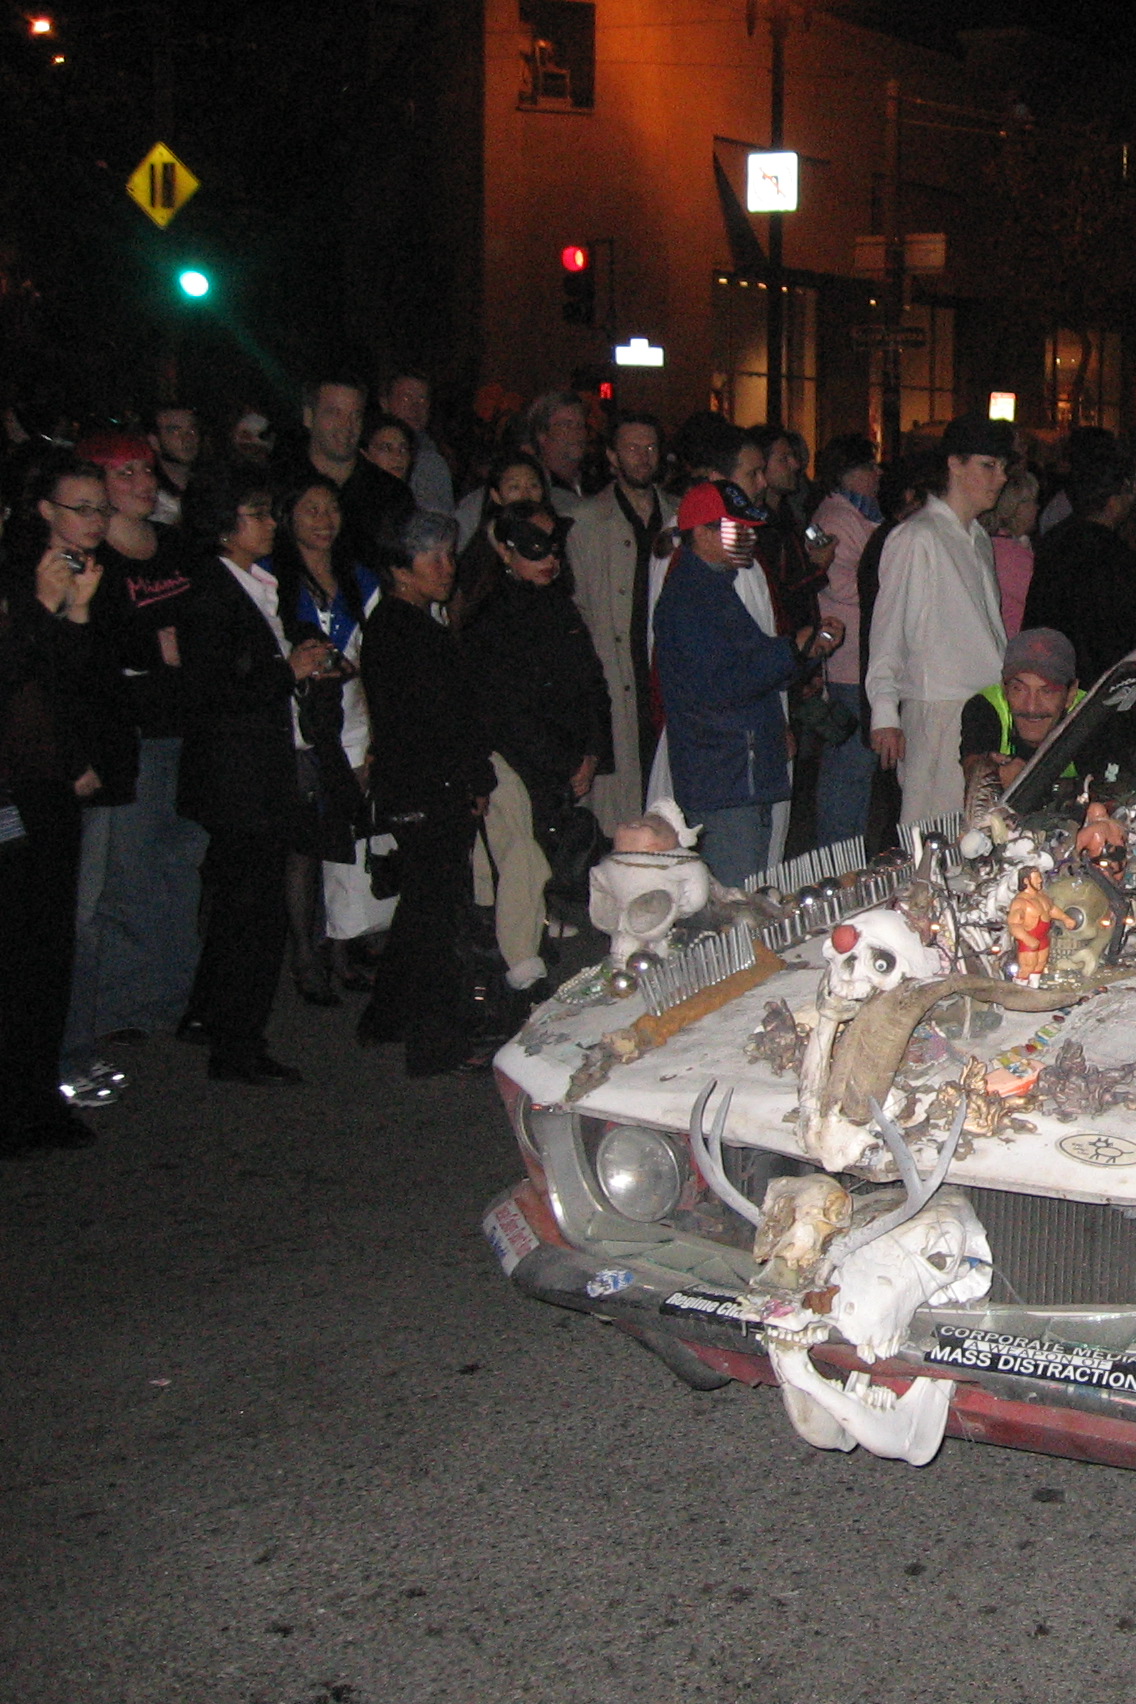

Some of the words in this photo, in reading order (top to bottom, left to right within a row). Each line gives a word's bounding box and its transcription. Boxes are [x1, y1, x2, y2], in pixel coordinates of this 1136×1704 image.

[665, 1293, 720, 1312] Regime
[941, 1325, 1064, 1354] CORPORATE
[930, 1345, 993, 1367] MASS
[966, 1340, 979, 1350] A
[988, 1343, 1073, 1364] WEAPON
[1081, 1357, 1112, 1370] OF
